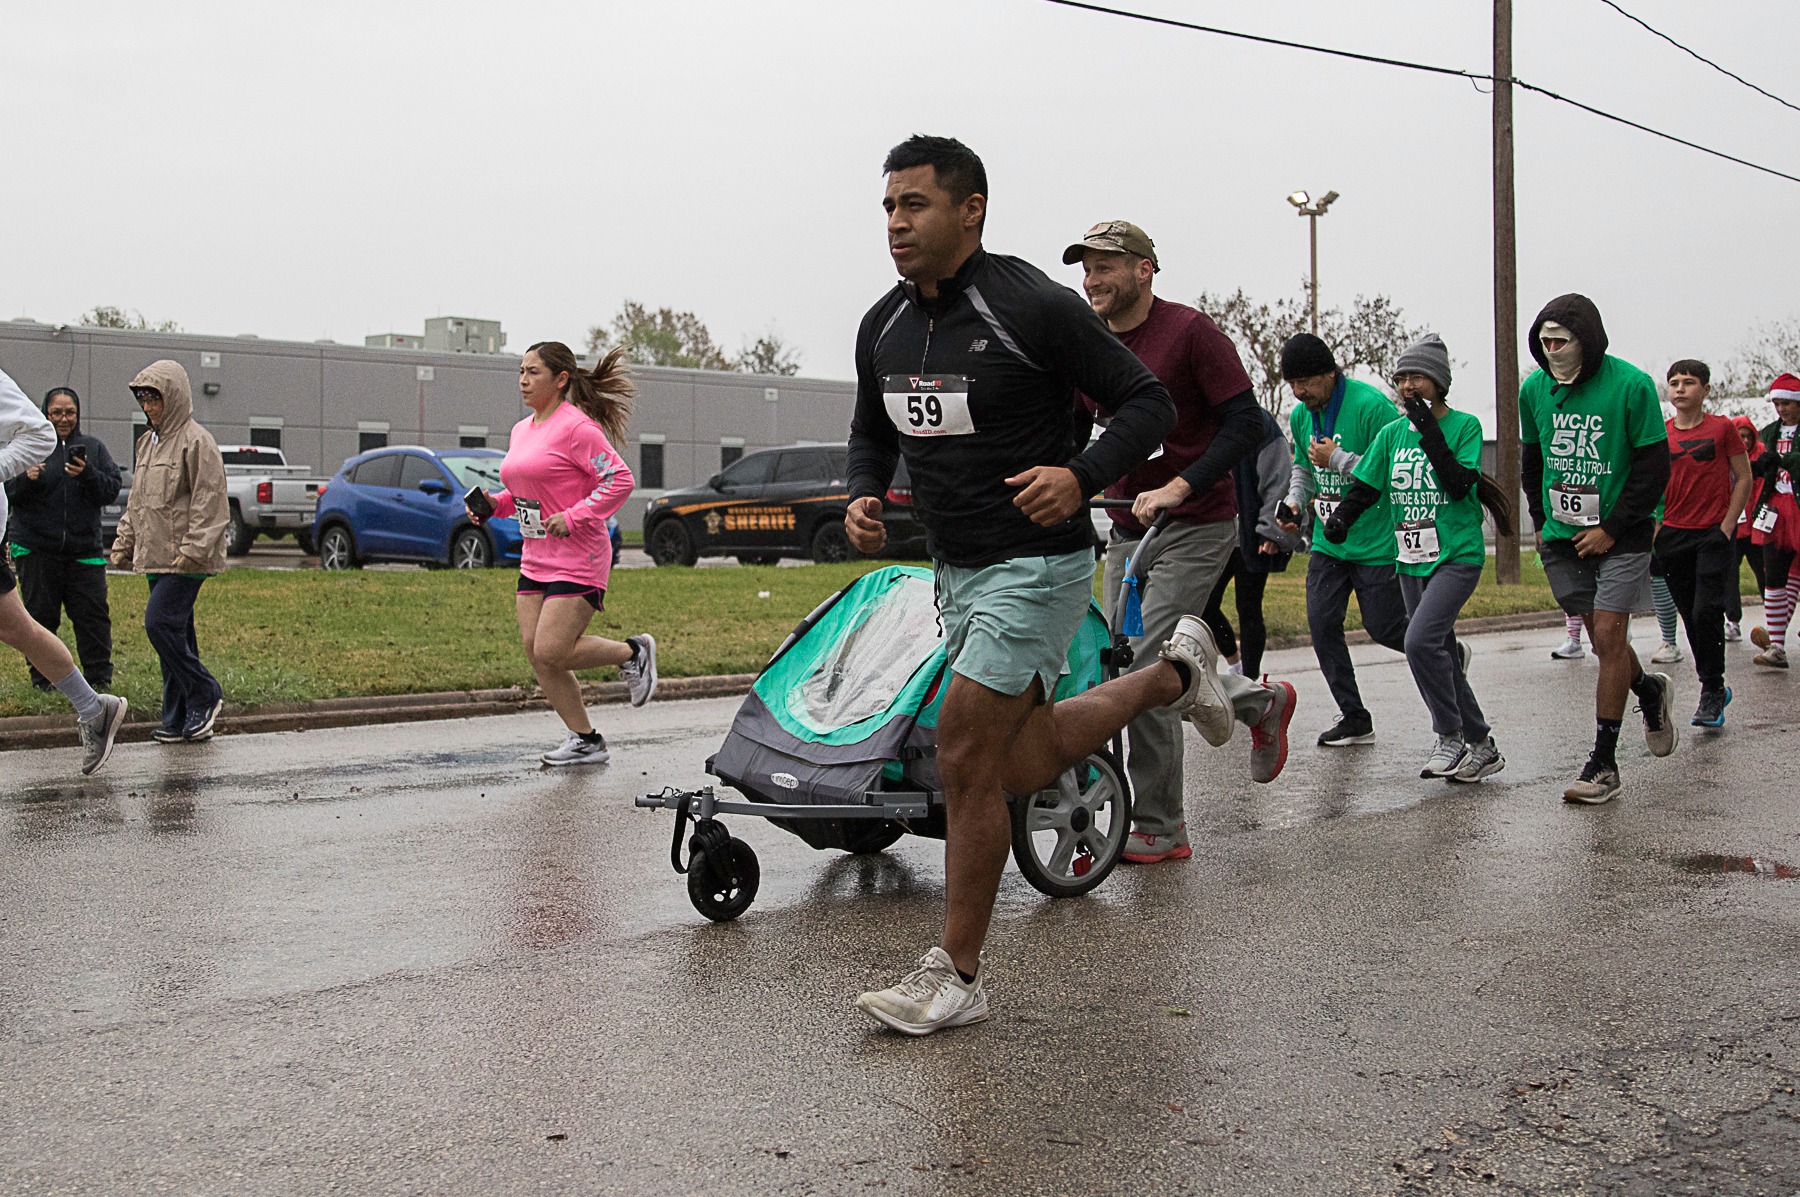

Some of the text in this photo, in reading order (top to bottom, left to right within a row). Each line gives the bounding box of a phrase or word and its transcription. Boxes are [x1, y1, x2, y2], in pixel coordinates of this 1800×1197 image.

[907, 395, 943, 427] 59
[1552, 413, 1603, 430] WCJC
[1549, 429, 1606, 460] 5K
[1393, 447, 1427, 462] WCJ
[1546, 456, 1612, 475] STRIDE & STROLL
[1390, 461, 1437, 490] 5K
[1561, 471, 1597, 486] 2024
[1413, 491, 1420, 505] &
[1420, 492, 1449, 505] STROLL
[1560, 493, 1582, 512] 66
[1319, 502, 1332, 517] 64
[1403, 505, 1436, 521] 2024
[724, 514, 796, 531] SHERIFF
[1403, 531, 1421, 549] 67
